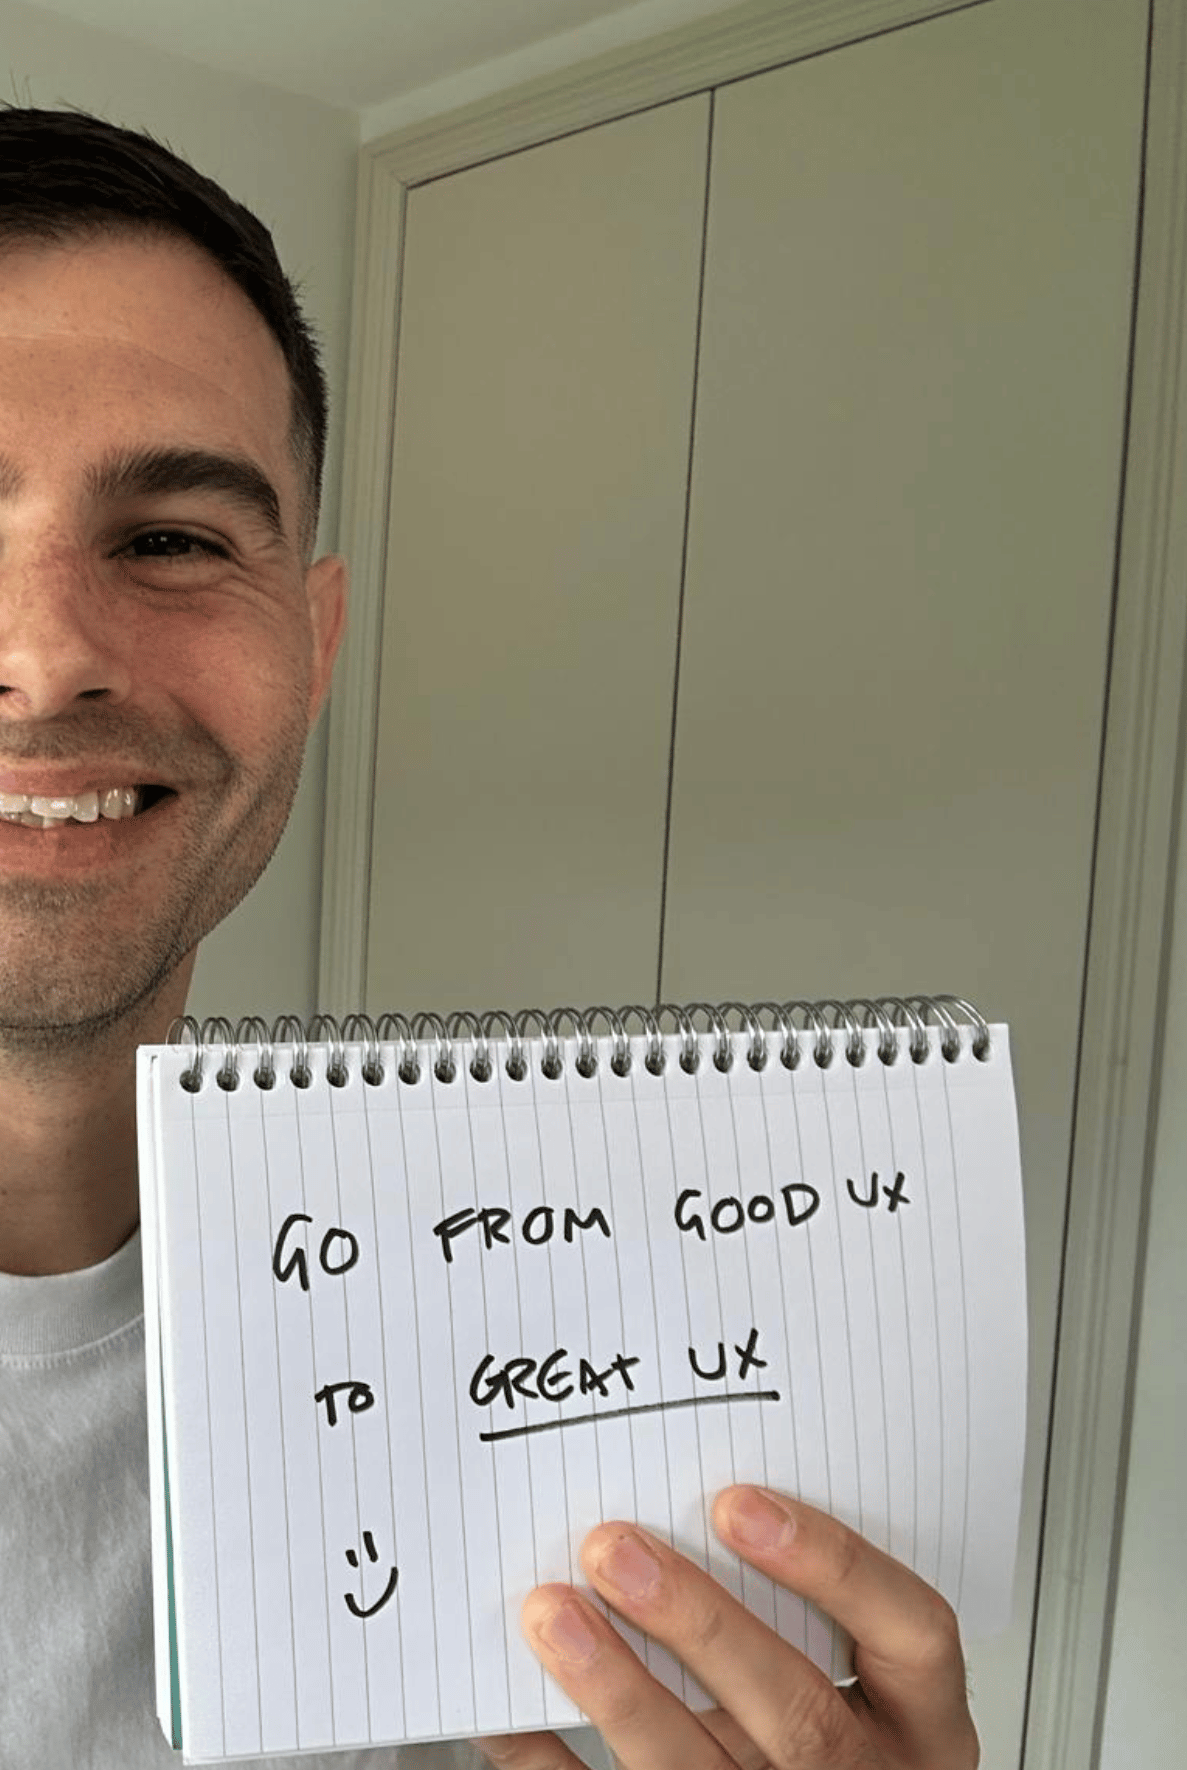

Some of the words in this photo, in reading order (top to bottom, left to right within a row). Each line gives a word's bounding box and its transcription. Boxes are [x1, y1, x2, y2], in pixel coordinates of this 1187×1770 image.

[272, 1213, 359, 1292] GO
[432, 1206, 611, 1264] FROM
[674, 1183, 820, 1241] GOOD
[846, 1171, 910, 1213] UX
[314, 1381, 375, 1427] TO
[469, 1348, 640, 1410] GREAT
[688, 1327, 768, 1381] UX
